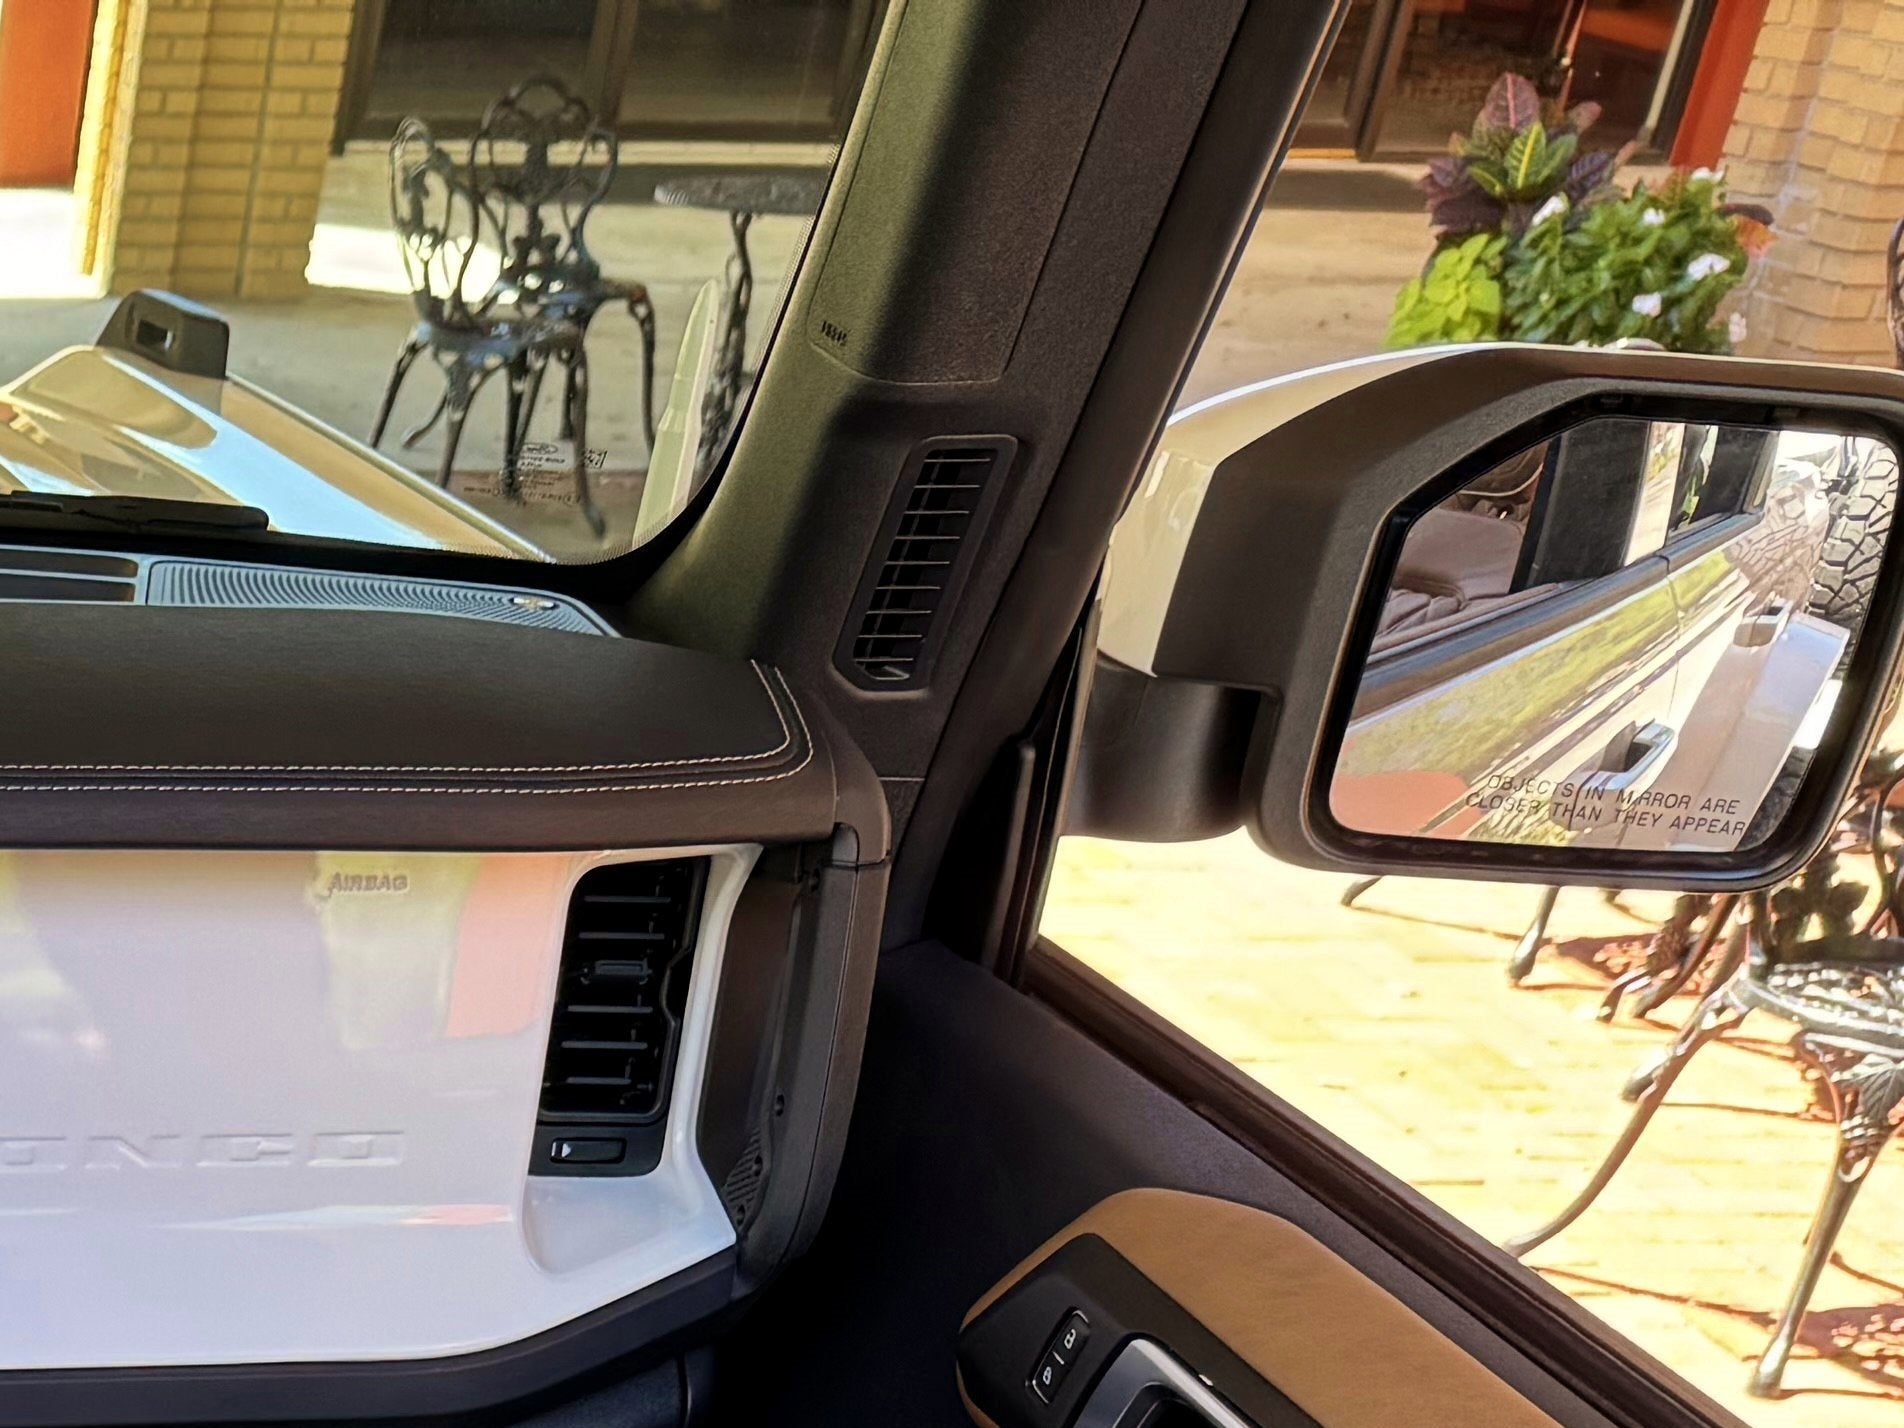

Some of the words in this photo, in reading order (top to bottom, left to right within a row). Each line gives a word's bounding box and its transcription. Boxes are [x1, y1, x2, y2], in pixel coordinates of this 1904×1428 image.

[1465, 792, 1541, 814] CLOSER
[1551, 802, 1603, 822] THAN
[1613, 809, 1660, 827] THEY
[1669, 816, 1745, 836] APPEAR
[1487, 774, 1573, 798] OBJECTS
[1583, 786, 1604, 801] IN
[1699, 797, 1740, 815] ARE
[328, 871, 409, 893] AIRBAG
